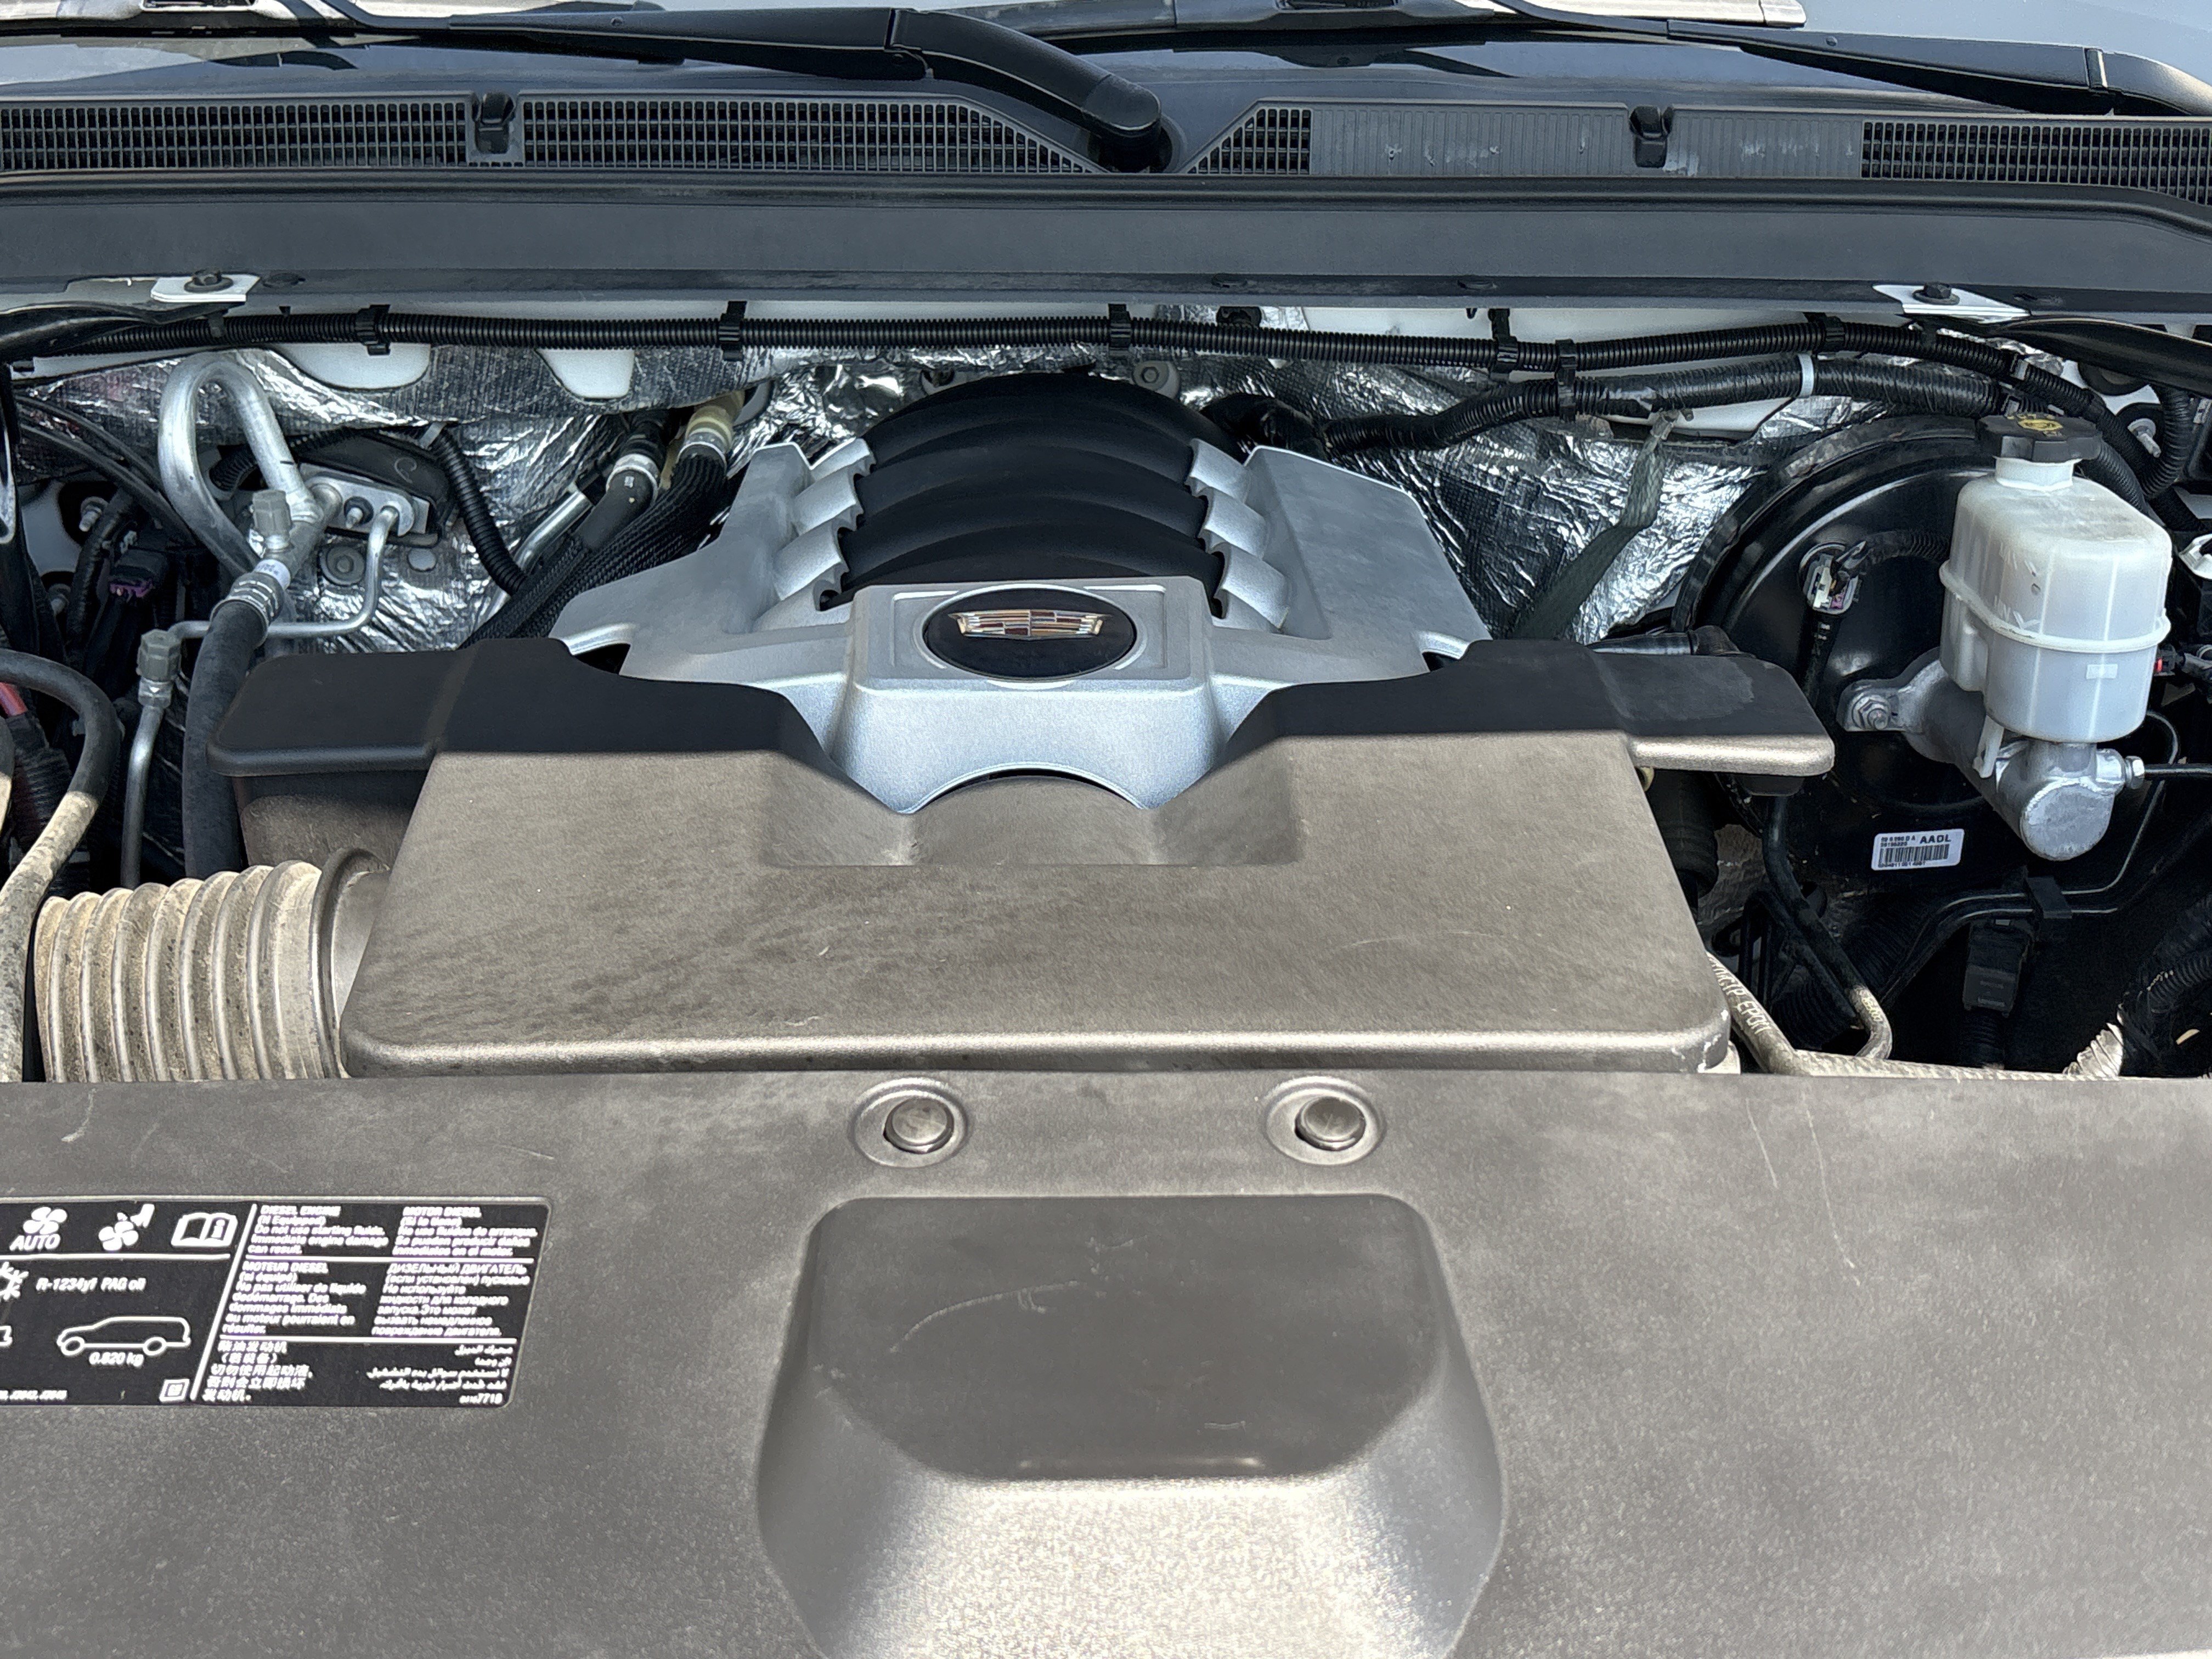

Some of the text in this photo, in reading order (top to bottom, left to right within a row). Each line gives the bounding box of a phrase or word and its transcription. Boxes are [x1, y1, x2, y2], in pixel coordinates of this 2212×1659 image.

[261, 1205, 297, 1215] DIESEL
[271, 1225, 290, 1234] not
[312, 1226, 352, 1237] starting
[9, 1234, 61, 1251] AUTO
[308, 1236, 345, 1247] engine
[346, 1236, 388, 1248] damage
[242, 1261, 329, 1273] MOTEUR DIESEL
[101, 1278, 128, 1291] PAG
[128, 1278, 146, 1291] oil
[242, 1314, 282, 1324] moteur
[340, 1316, 355, 1325] en
[127, 1352, 144, 1367] kg
